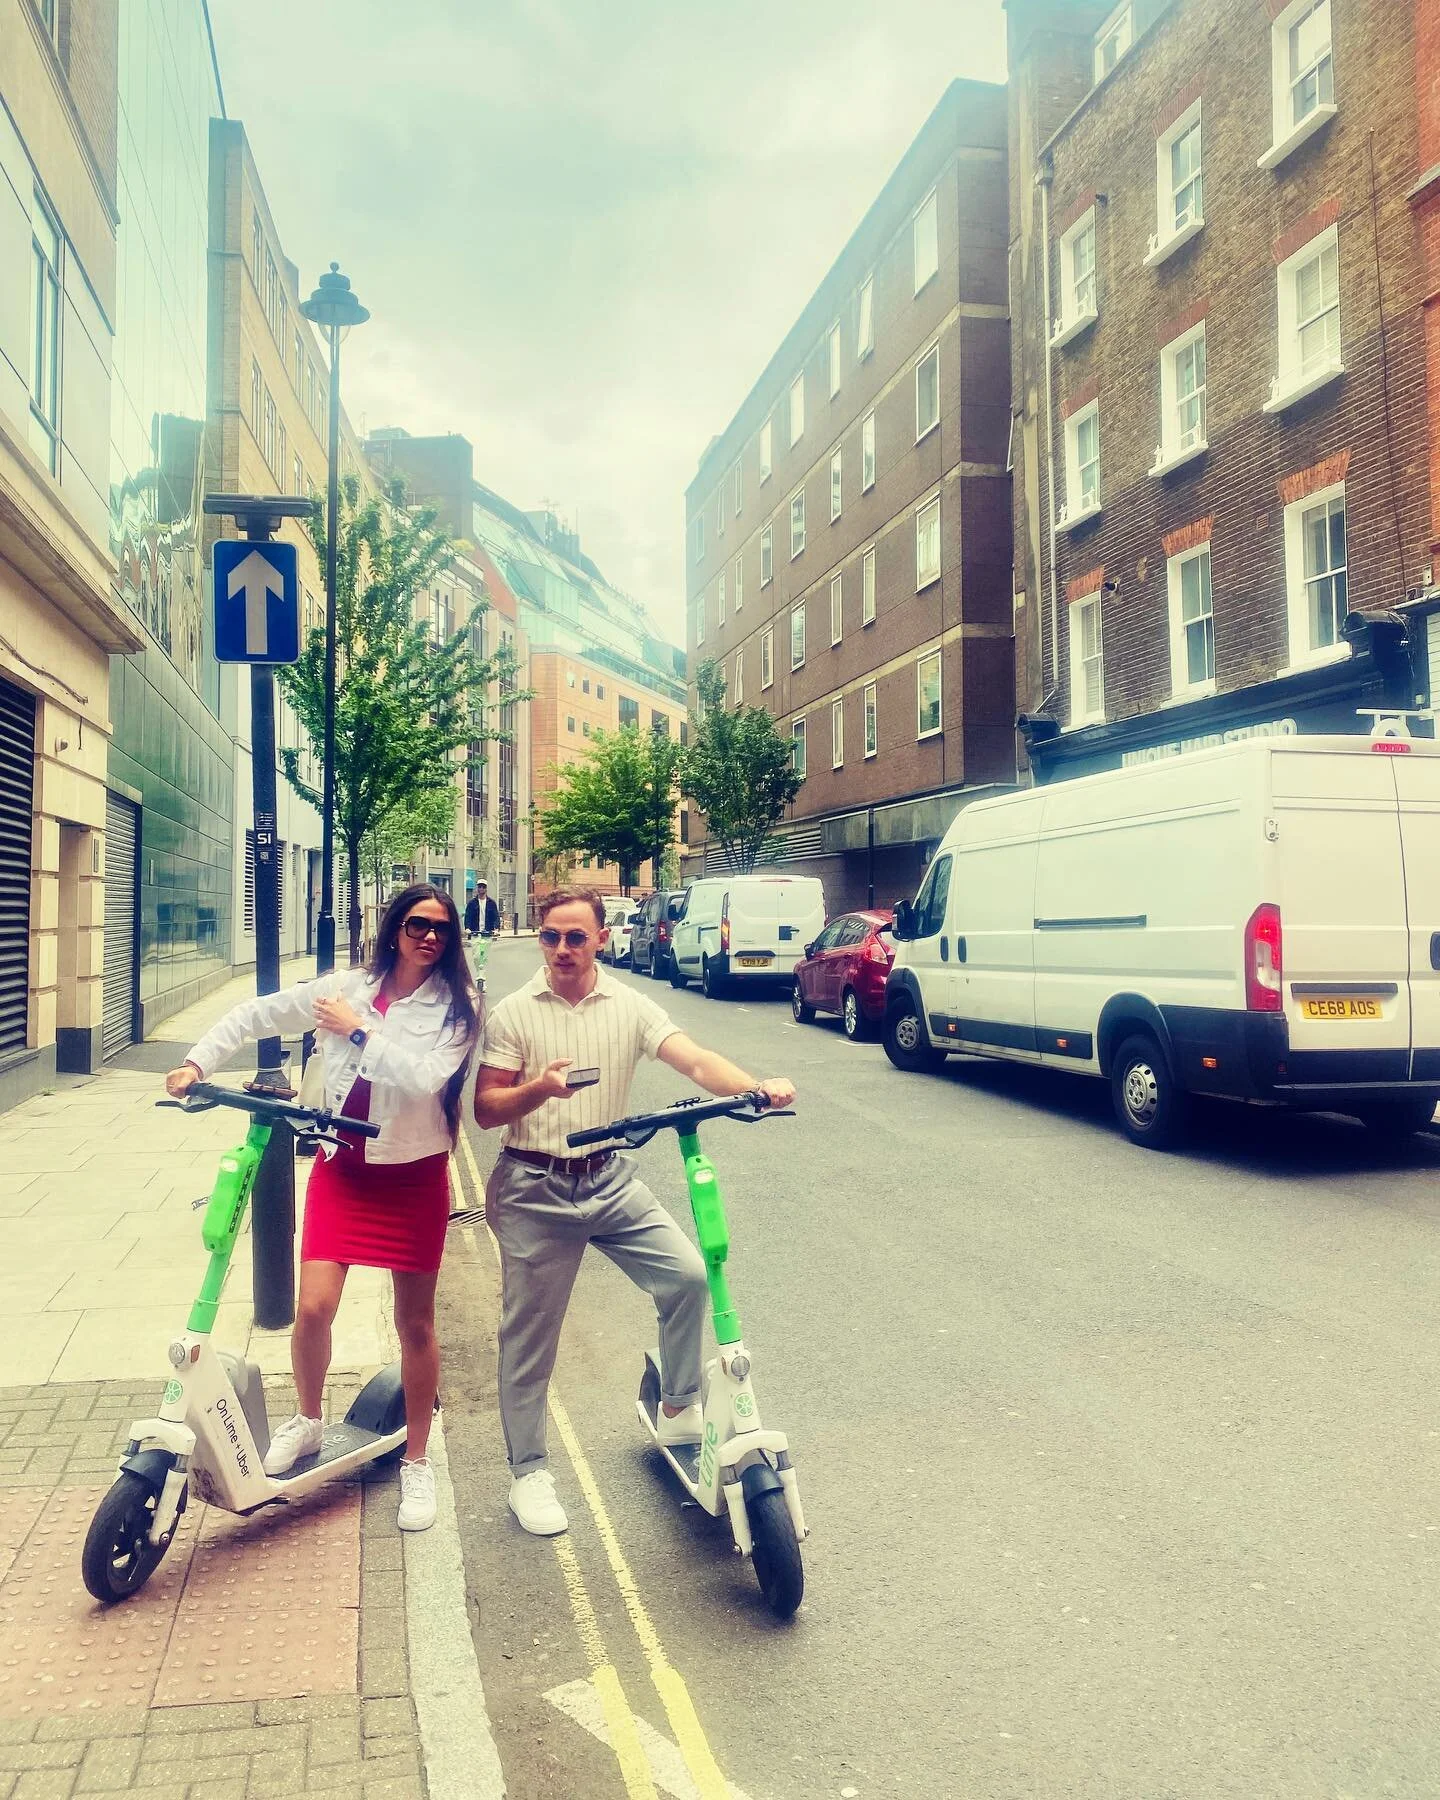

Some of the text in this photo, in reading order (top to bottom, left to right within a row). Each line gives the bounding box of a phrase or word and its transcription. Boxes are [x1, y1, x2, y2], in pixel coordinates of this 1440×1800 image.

[1308, 1001, 1376, 1015] CE68 AOS
[216, 1398, 228, 1418] On
[223, 1414, 238, 1444] Lime
[236, 1448, 250, 1477] Uber
